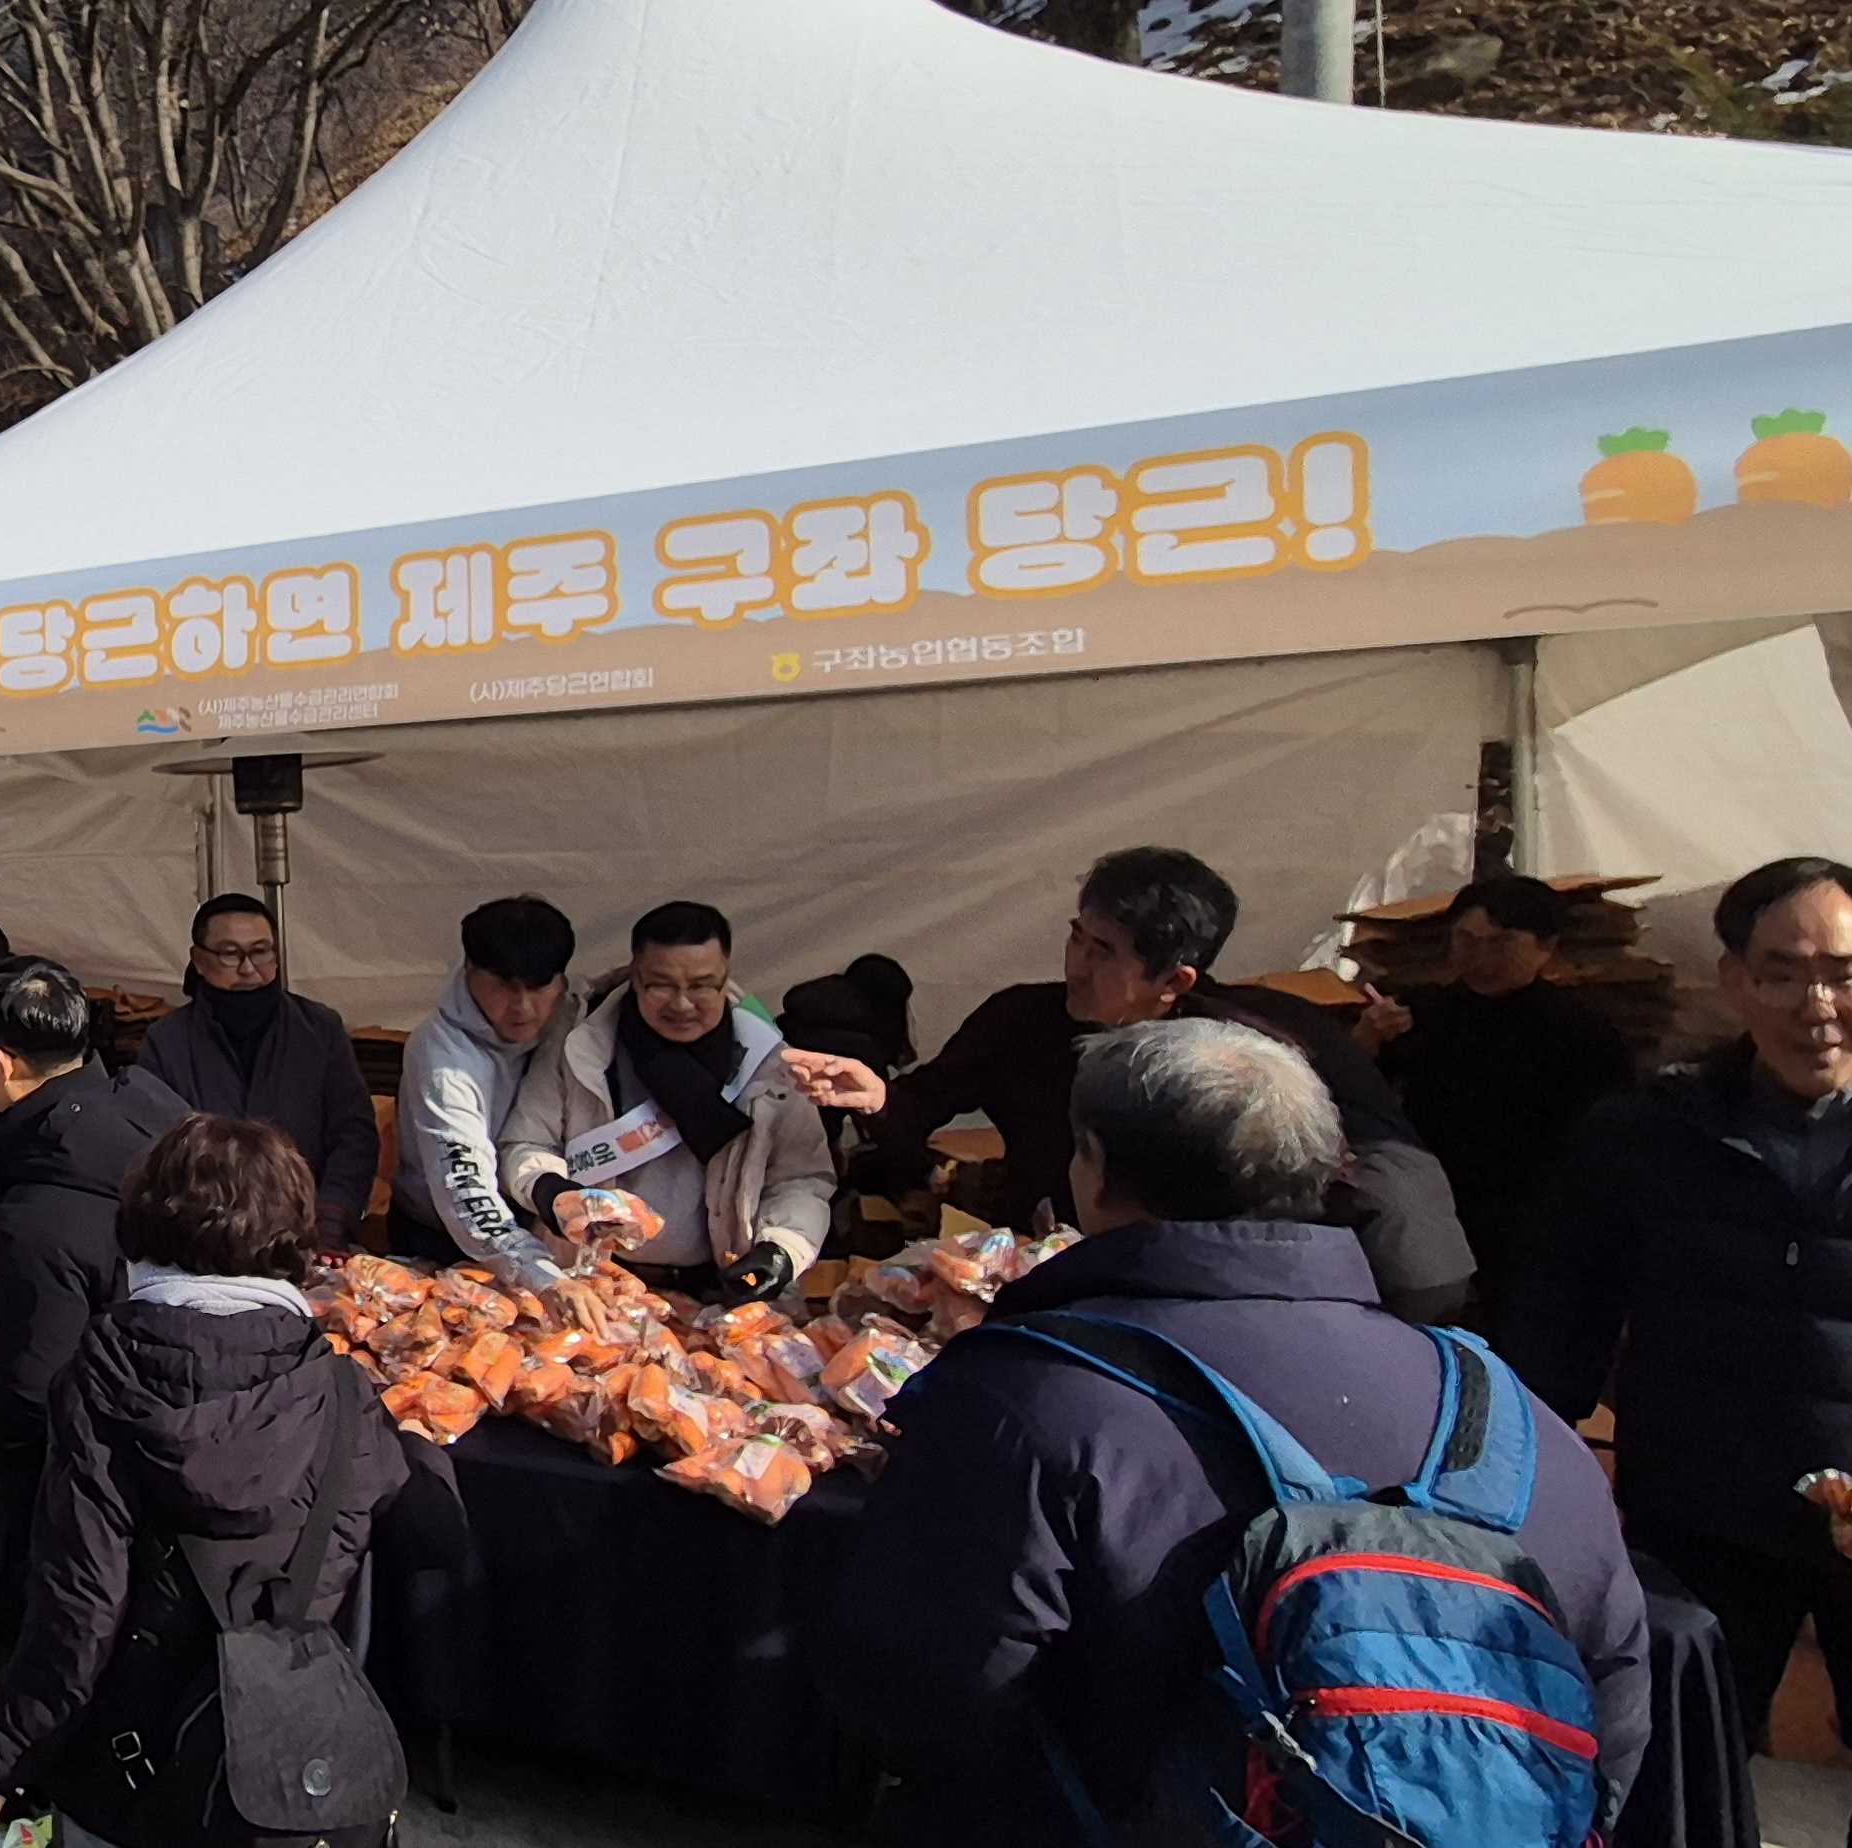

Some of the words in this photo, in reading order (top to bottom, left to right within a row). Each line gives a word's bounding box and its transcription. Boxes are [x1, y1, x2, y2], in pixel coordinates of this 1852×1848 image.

[390, 529, 618, 658] 제주
[655, 489, 932, 630] 구좌
[966, 430, 1372, 598] 당근!
[812, 627, 1086, 673] 구좌농업협동조합
[470, 667, 653, 704] (사)제주당근연합회
[218, 702, 378, 730] 제주농산물수급관리센터
[460, 1196, 511, 1237] ERA
